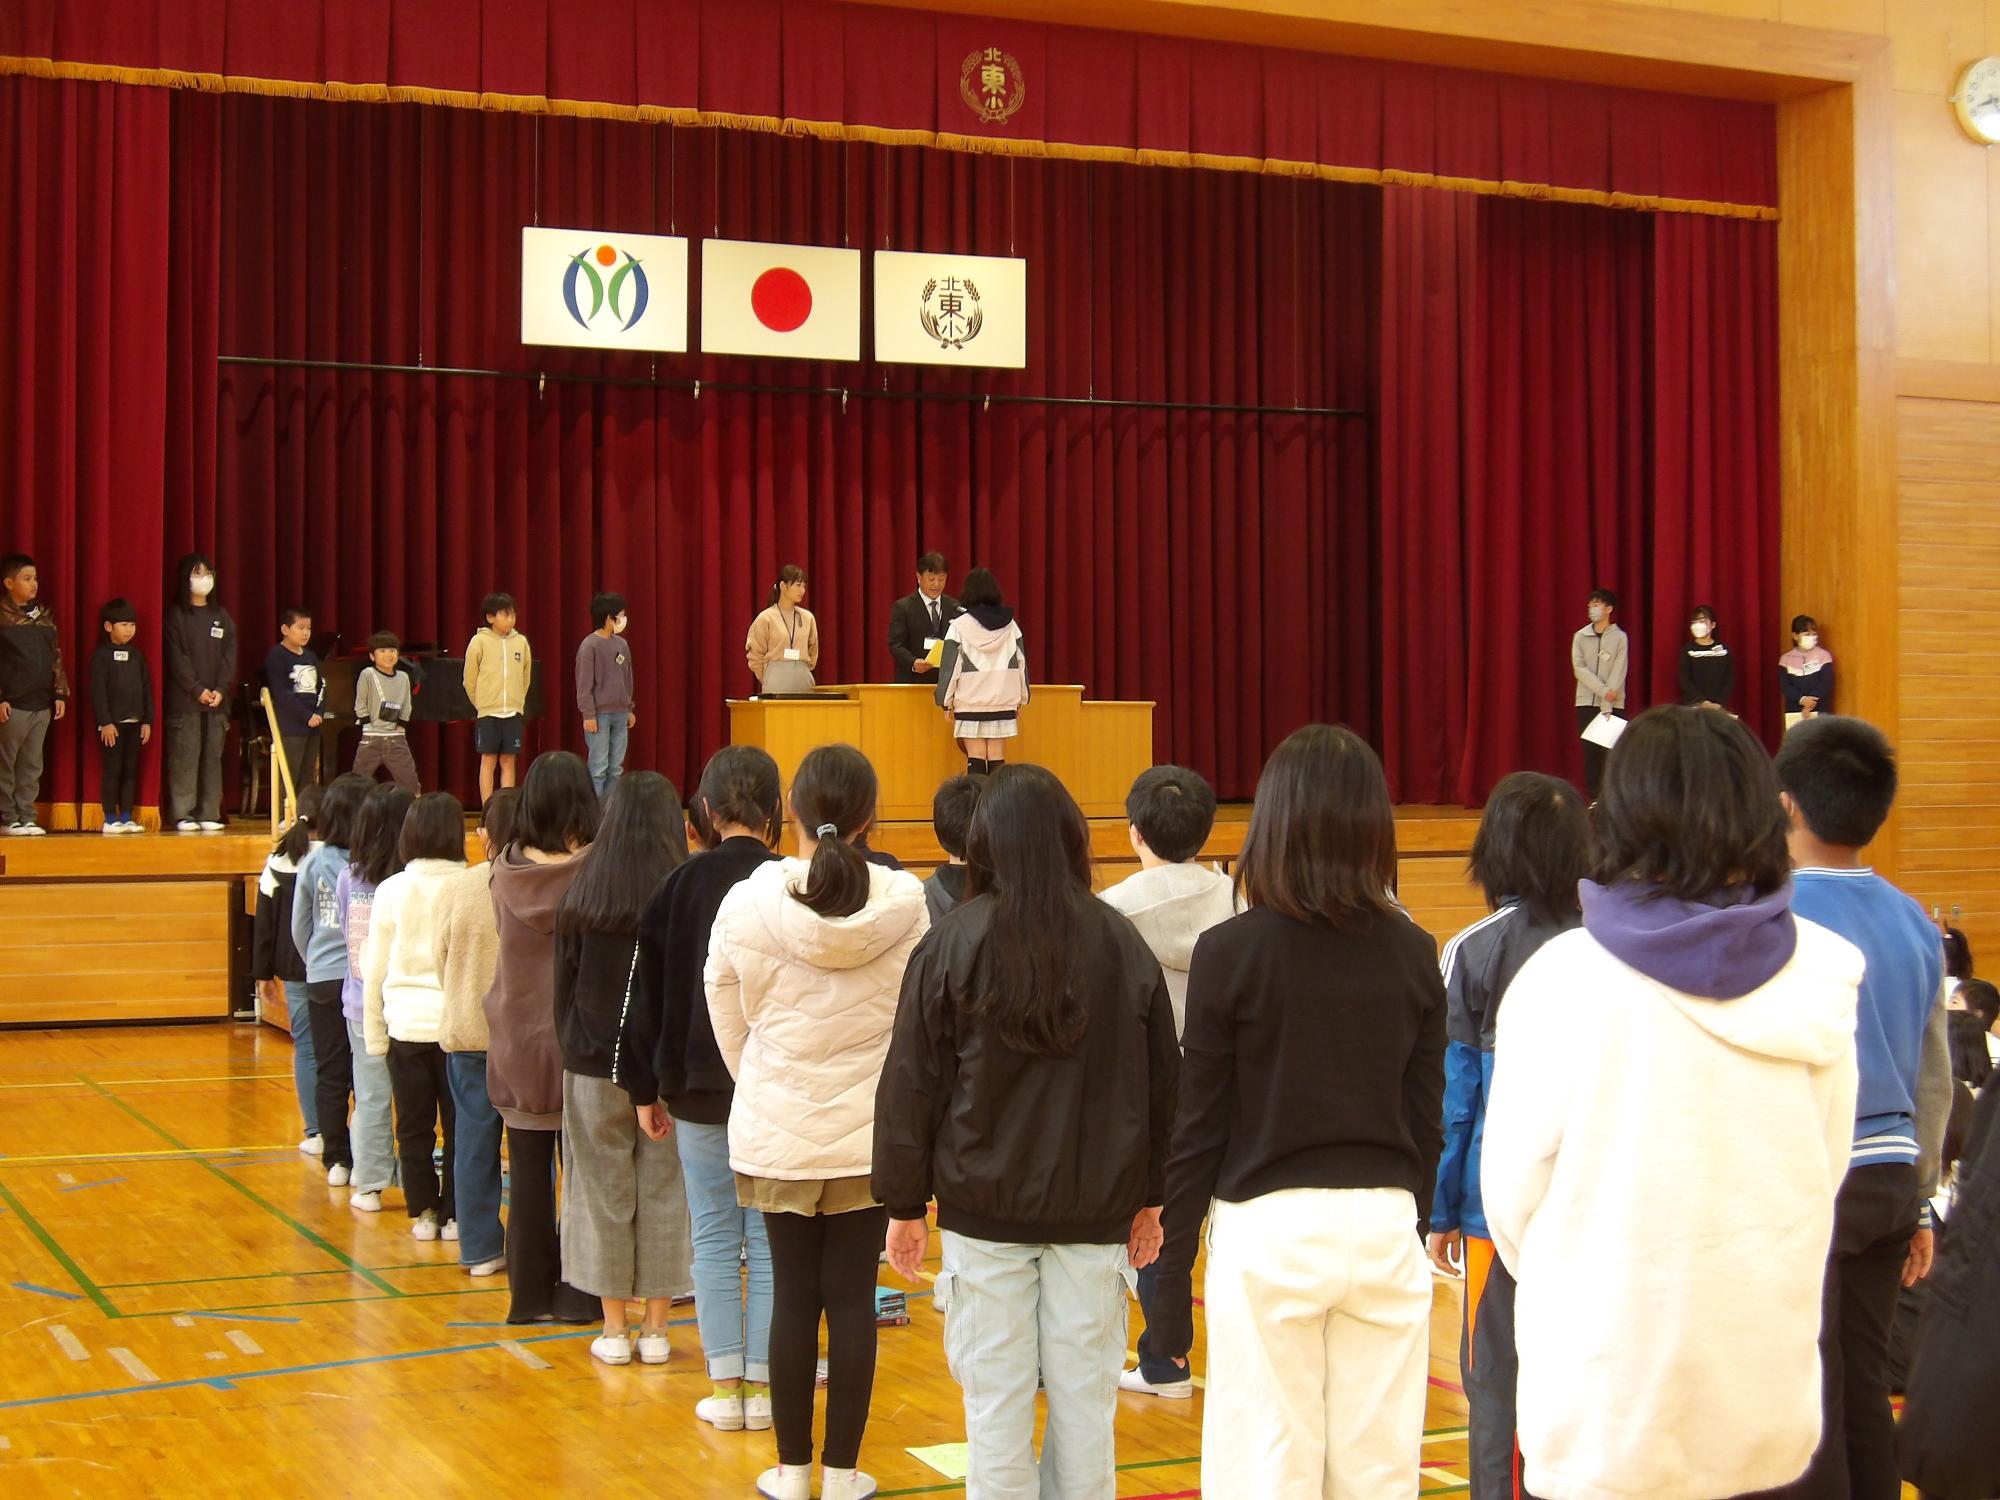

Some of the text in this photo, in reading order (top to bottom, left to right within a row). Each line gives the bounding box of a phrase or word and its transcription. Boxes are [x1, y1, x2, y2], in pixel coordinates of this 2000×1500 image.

[981, 47, 1006, 109] 北東小
[939, 276, 965, 338] 北東小
